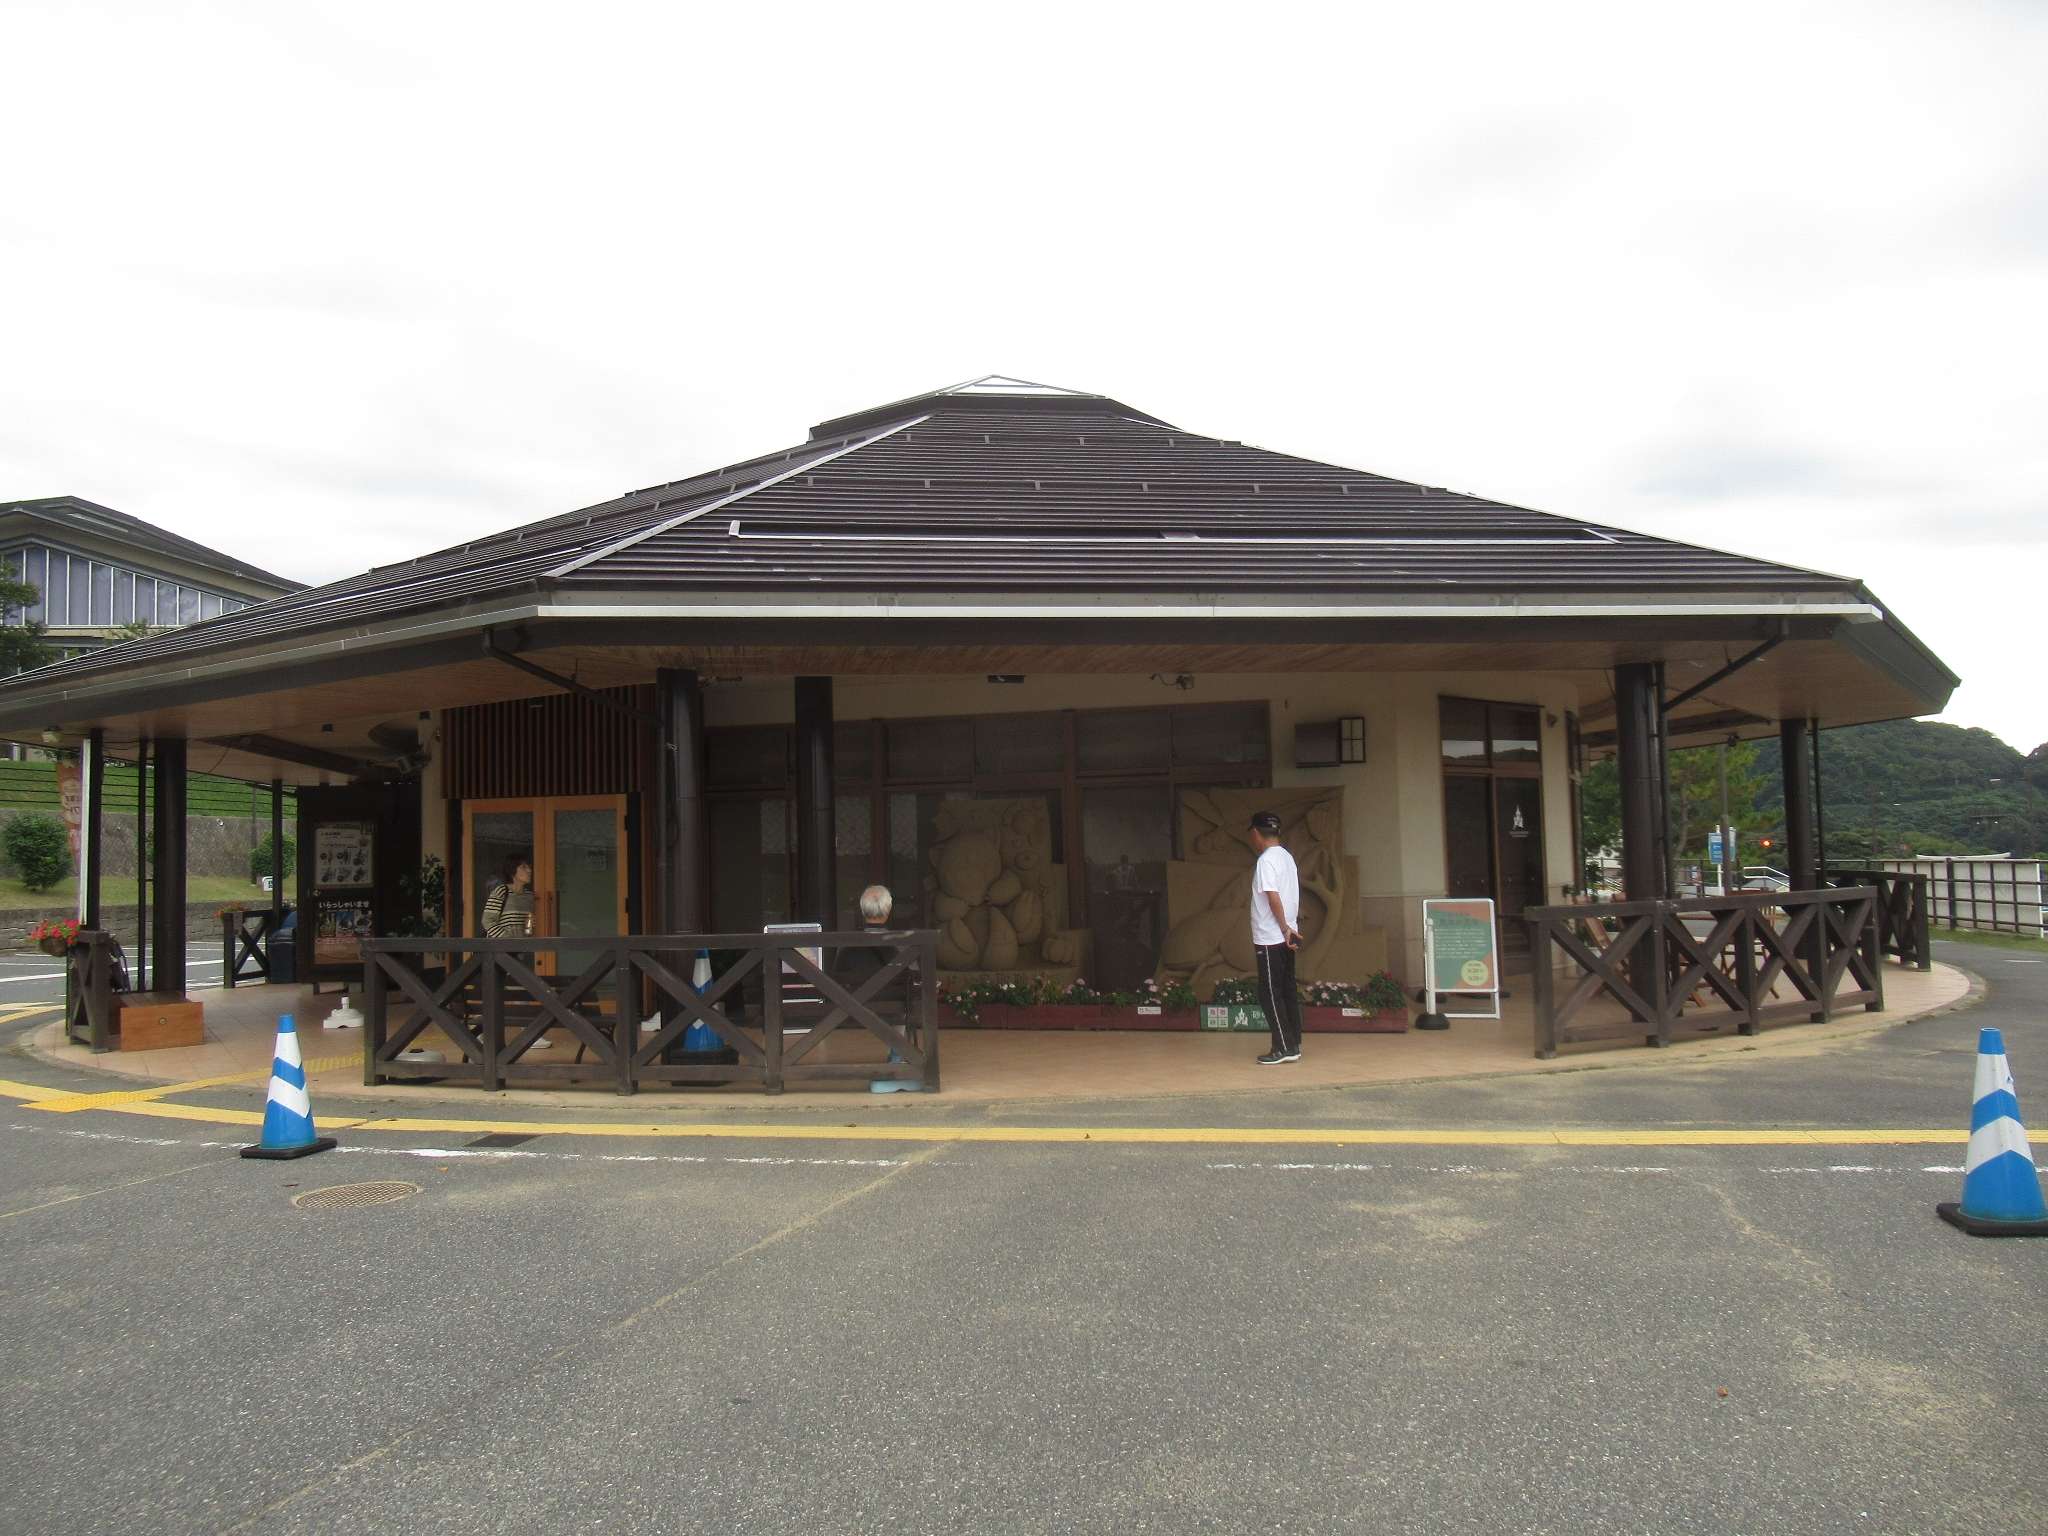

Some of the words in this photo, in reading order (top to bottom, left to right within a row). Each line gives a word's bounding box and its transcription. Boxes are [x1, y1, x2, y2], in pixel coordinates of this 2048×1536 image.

[318, 900, 370, 909] いらっしゃいませ
